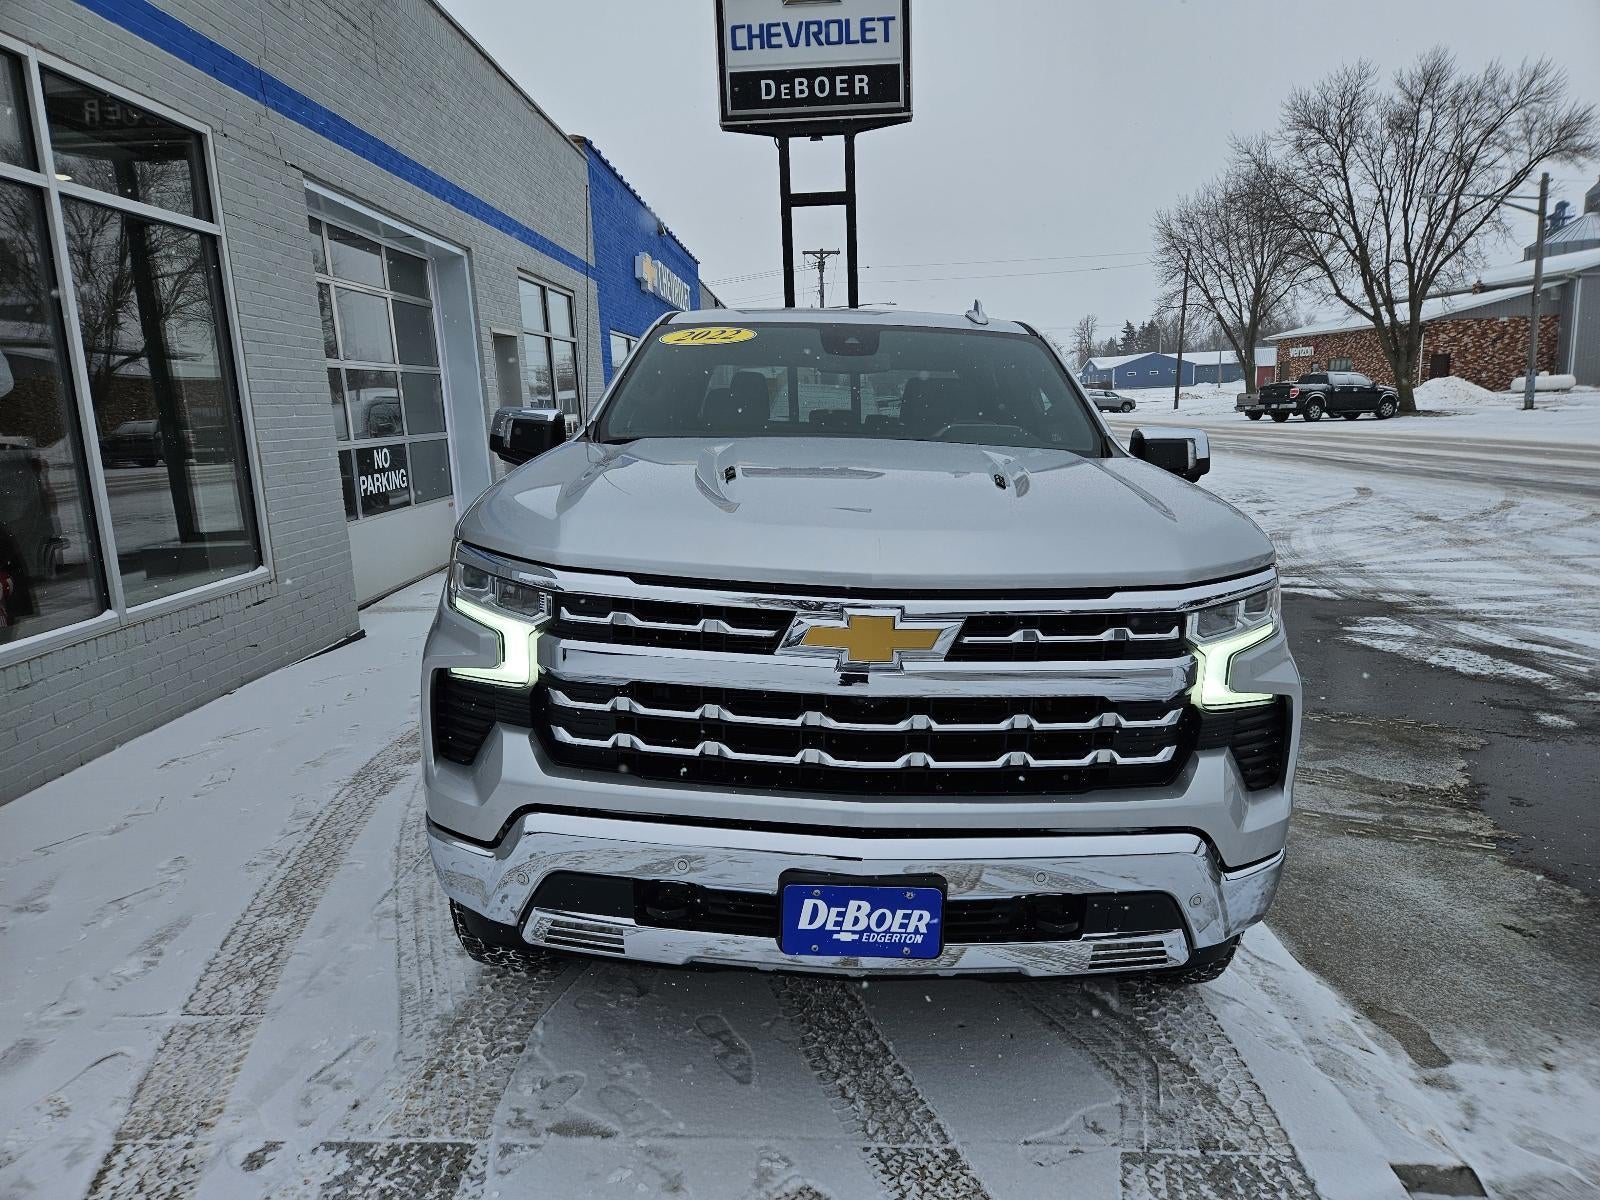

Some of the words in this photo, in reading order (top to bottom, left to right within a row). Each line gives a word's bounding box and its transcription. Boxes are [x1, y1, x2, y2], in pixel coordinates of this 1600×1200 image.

[731, 16, 896, 51] CHEVROLET
[673, 329, 742, 342] 2022
[1289, 344, 1314, 358] verizon
[373, 447, 391, 470] NO
[359, 468, 408, 497] PARKING
[861, 932, 924, 944] EDGERTON
